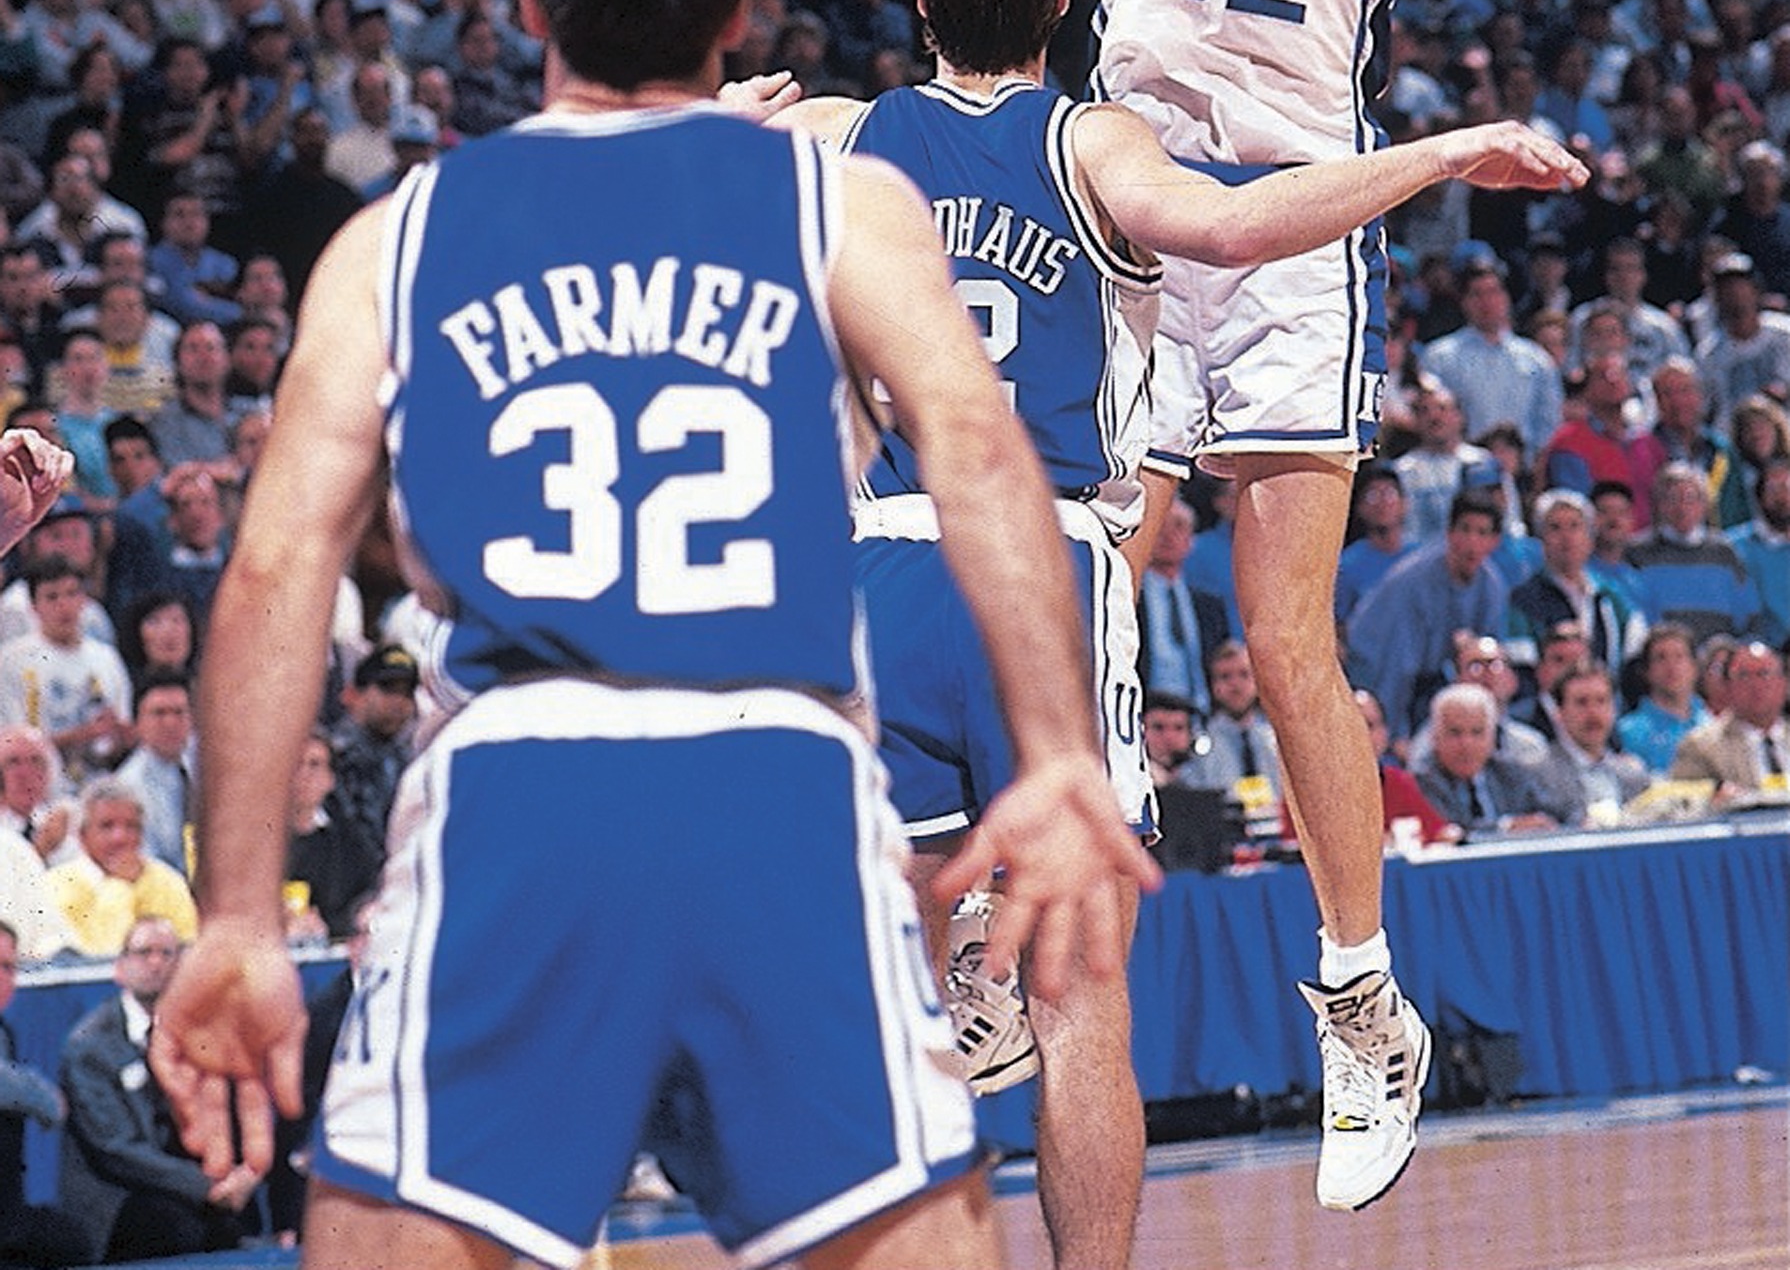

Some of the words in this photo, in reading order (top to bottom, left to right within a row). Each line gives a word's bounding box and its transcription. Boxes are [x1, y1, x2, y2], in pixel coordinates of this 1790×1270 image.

[438, 256, 801, 401] FARMER
[482, 381, 777, 616] 32
[1115, 682, 1138, 745] U
